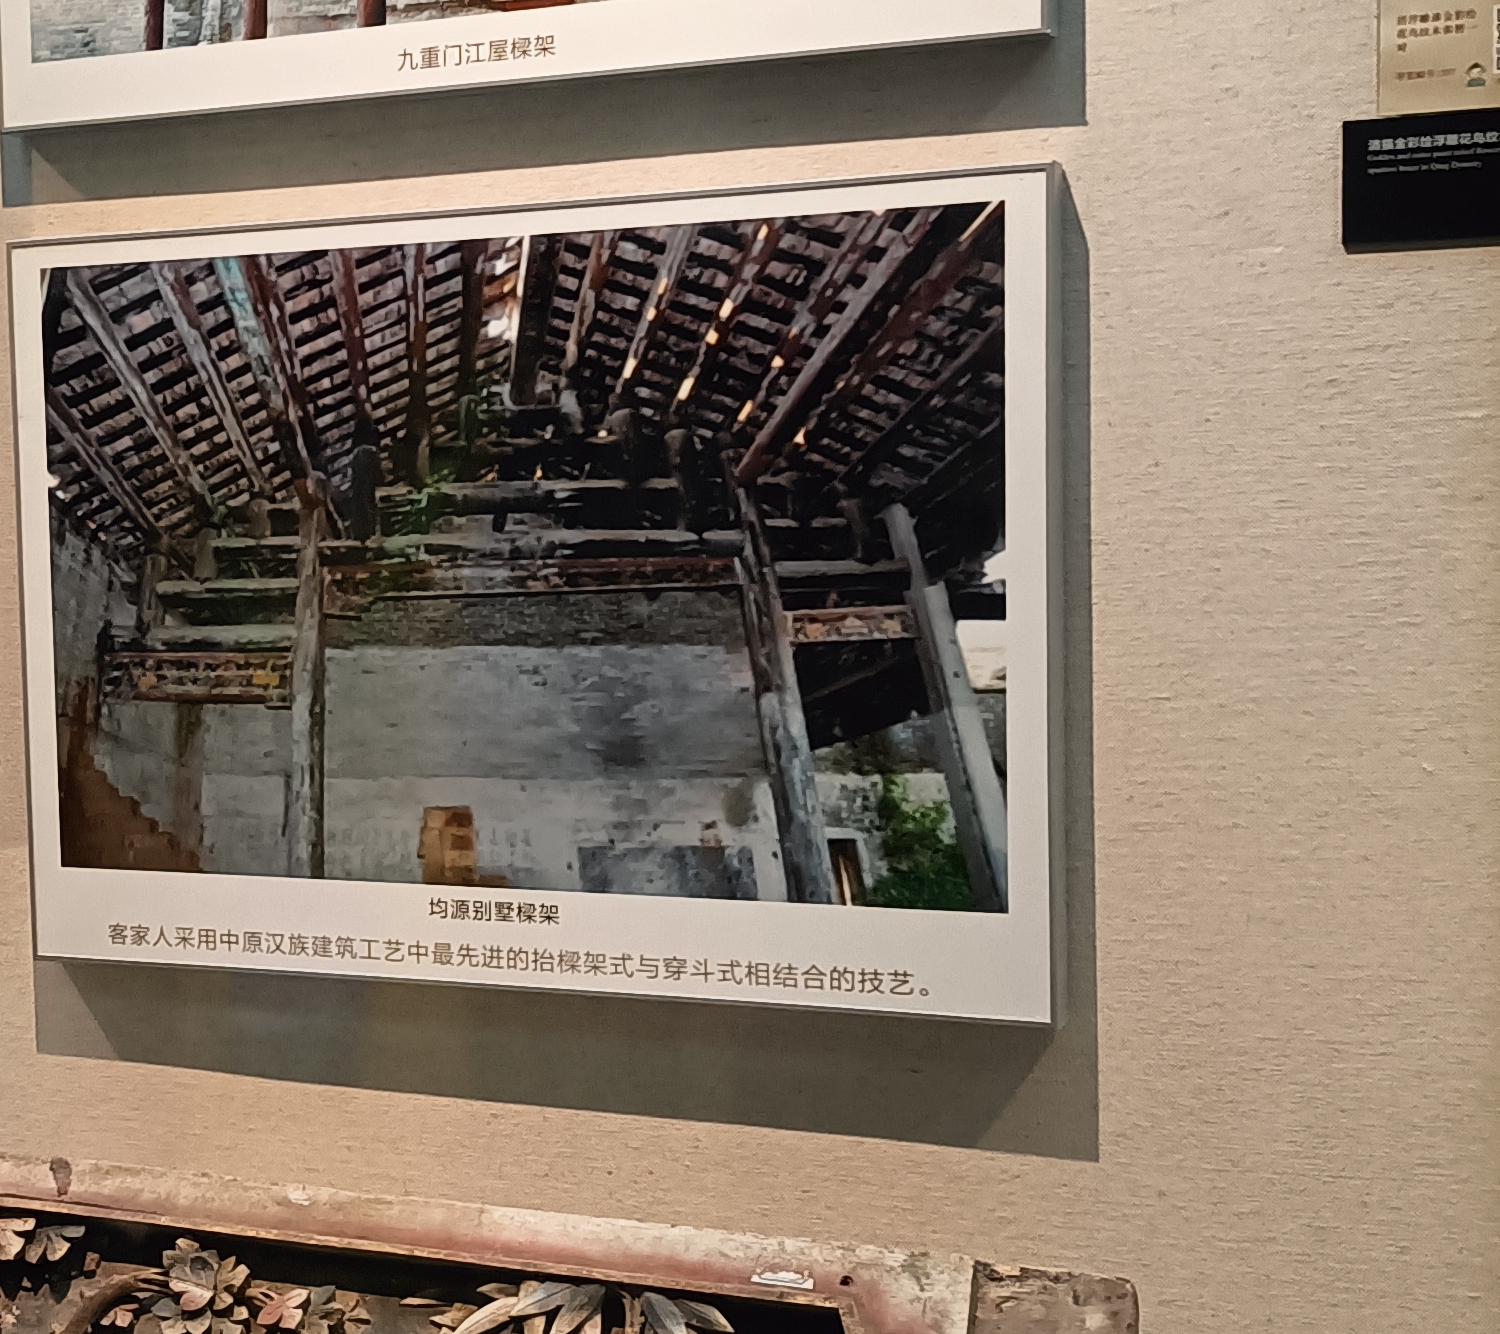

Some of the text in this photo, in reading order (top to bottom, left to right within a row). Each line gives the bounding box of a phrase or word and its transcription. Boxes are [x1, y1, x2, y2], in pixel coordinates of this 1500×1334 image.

[397, 34, 556, 72] 九重门江屋樑架
[428, 897, 560, 926] 均源别墅樑架
